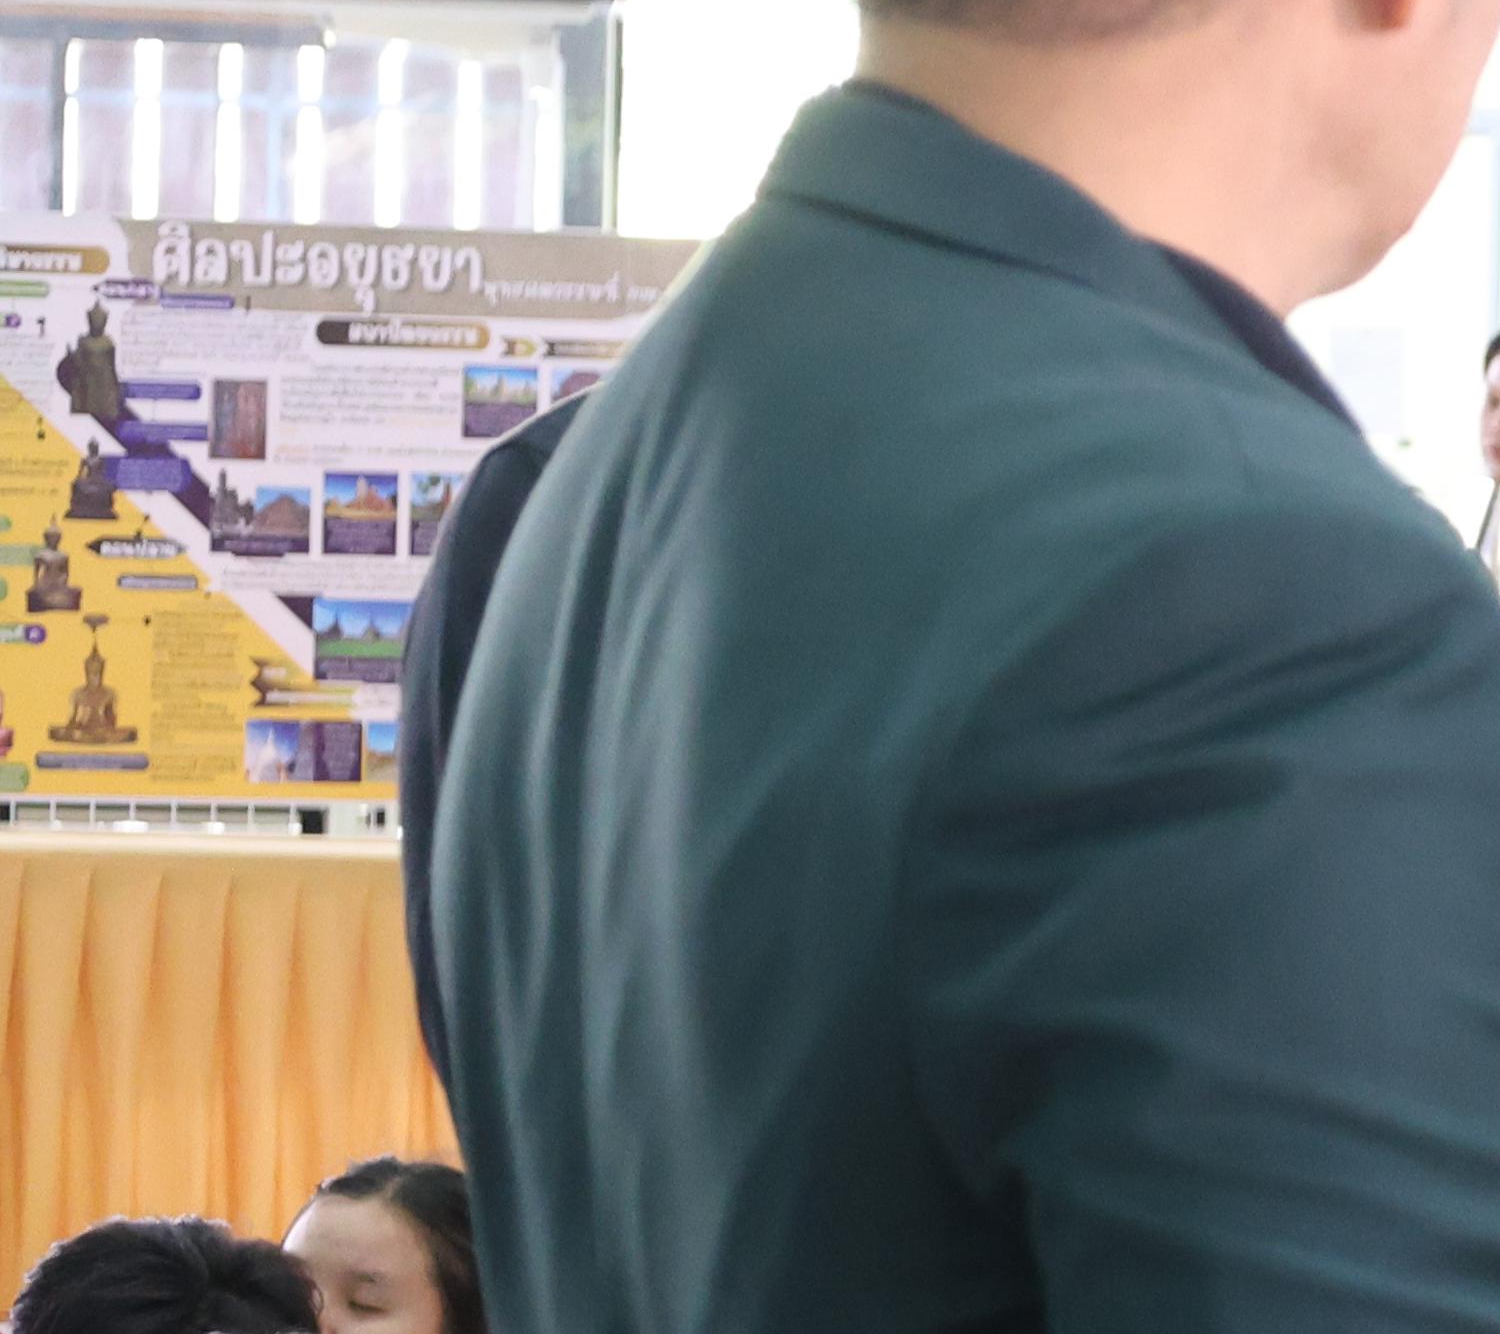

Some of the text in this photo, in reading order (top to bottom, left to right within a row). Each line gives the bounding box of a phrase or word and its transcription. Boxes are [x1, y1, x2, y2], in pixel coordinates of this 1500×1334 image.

[152, 219, 484, 316] ศิลปะอยุธยา
